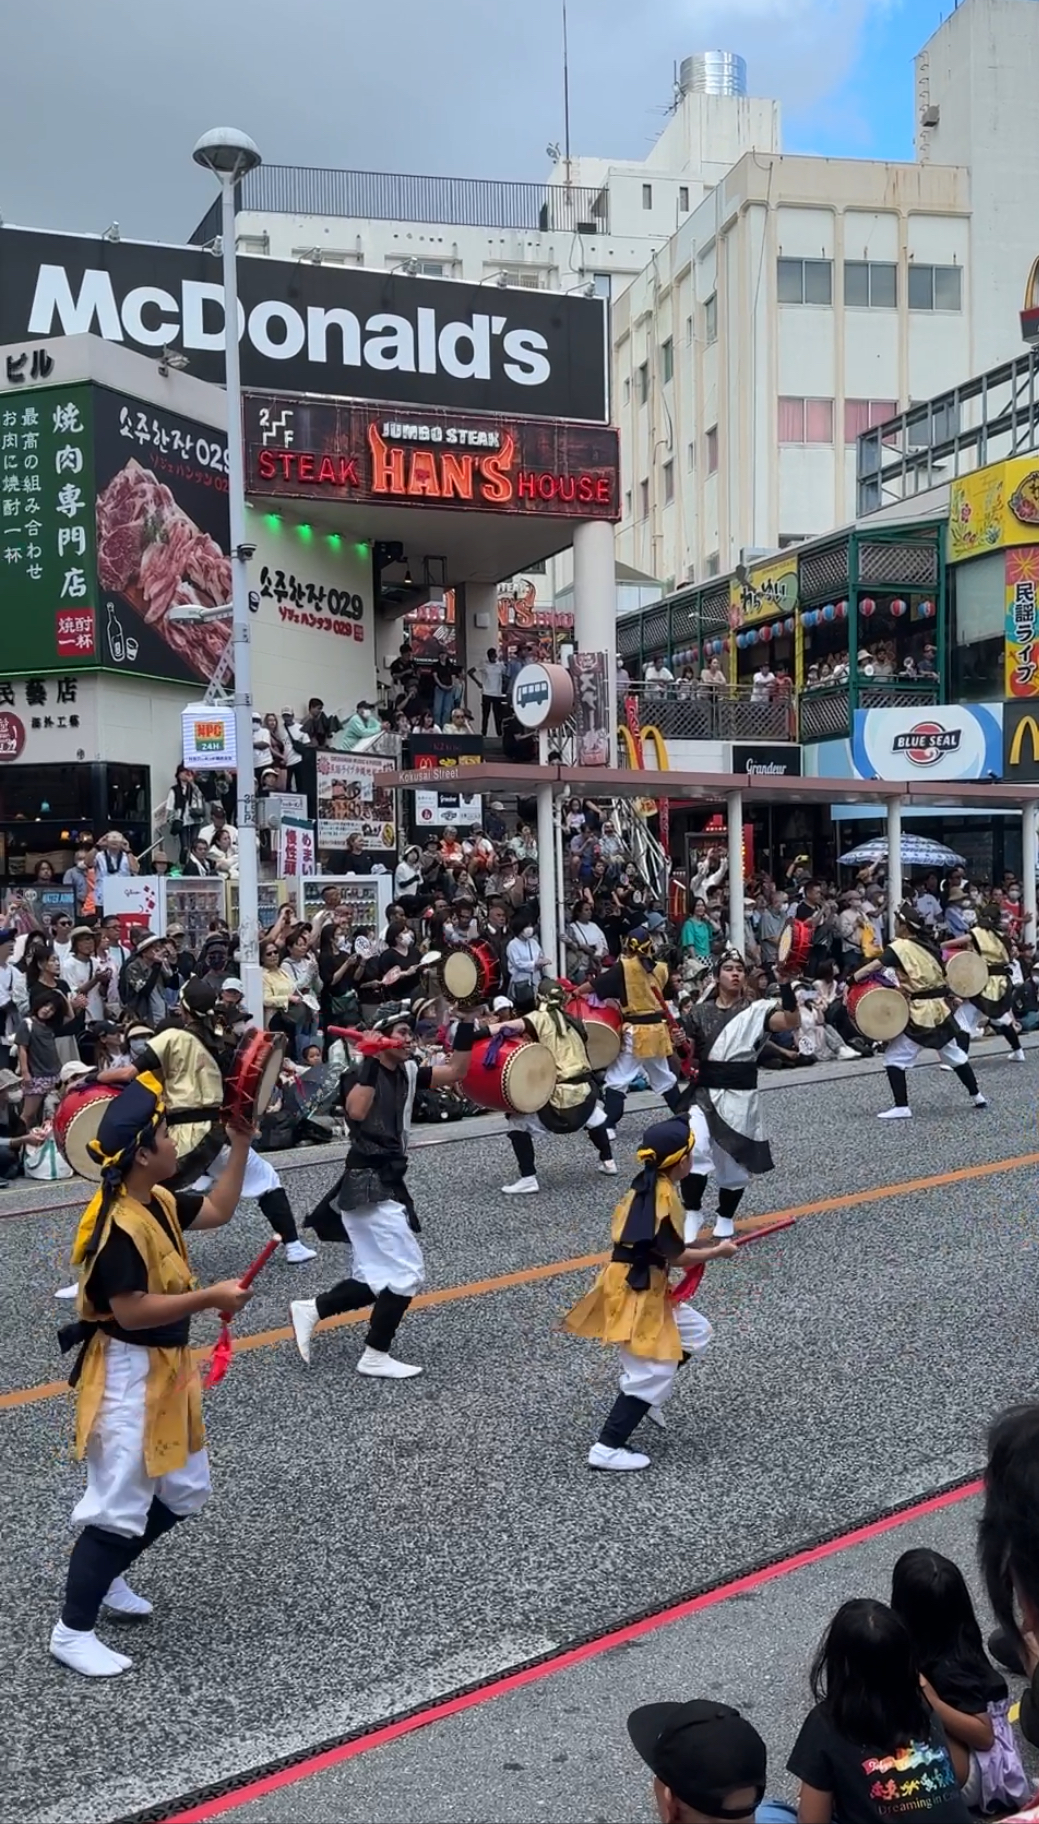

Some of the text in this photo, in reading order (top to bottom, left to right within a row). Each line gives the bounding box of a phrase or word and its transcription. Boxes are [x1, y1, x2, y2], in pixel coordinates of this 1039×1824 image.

[28, 264, 551, 386] McDonald's
[6, 348, 56, 384] ビル
[119, 406, 194, 460] 소주한잔
[382, 421, 500, 447] JUMBO STEAK
[2, 410, 22, 564] お肉に焼酎一杯
[259, 447, 611, 503] STEAK HAN'S HOUSE
[21, 407, 43, 580] 最高の組み合わせ
[53, 402, 87, 598] 焼肉専門店
[260, 566, 364, 620] 소주한잔 029
[58, 634, 93, 649] 一杯
[333, 619, 353, 637] 029
[1015, 583, 1035, 683] 民謡ライブ
[196, 724, 222, 738] NPC
[201, 742, 220, 750] 24H
[897, 734, 957, 748] BLUE SEAL
[399, 766, 459, 782] Kokusai Street
[745, 758, 787, 775] Grandeur
[302, 832, 313, 876] めまい
[878, 1796, 932, 1815] Dreaming
